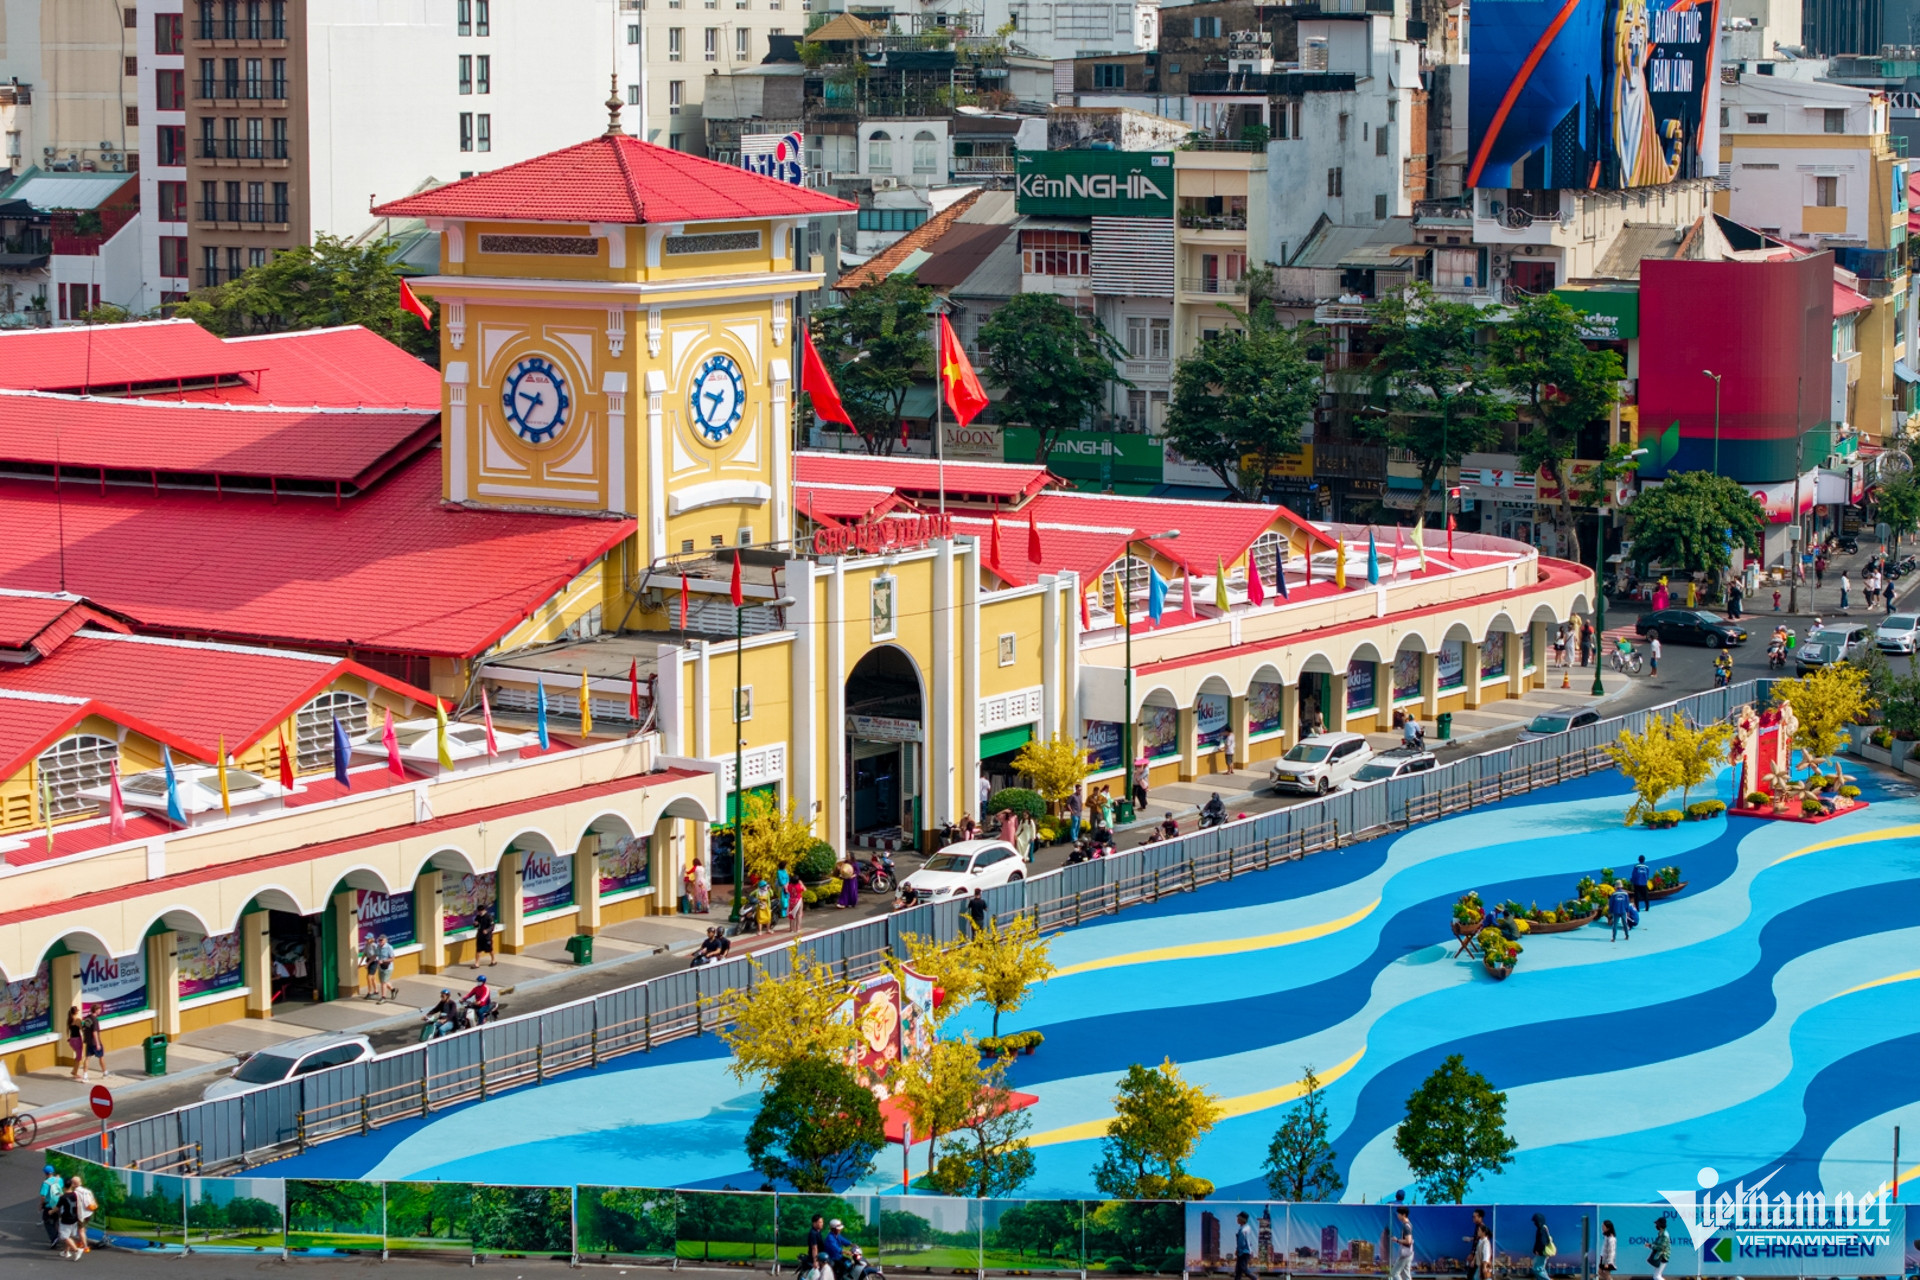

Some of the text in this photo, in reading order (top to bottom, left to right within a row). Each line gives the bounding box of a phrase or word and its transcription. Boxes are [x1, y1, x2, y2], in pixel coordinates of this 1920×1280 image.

[947, 429, 995, 445] MOON
[357, 890, 390, 921] Vikki
[391, 902, 408, 913] Bank
[80, 954, 118, 986] Vikki
[120, 967, 140, 978] Bank
